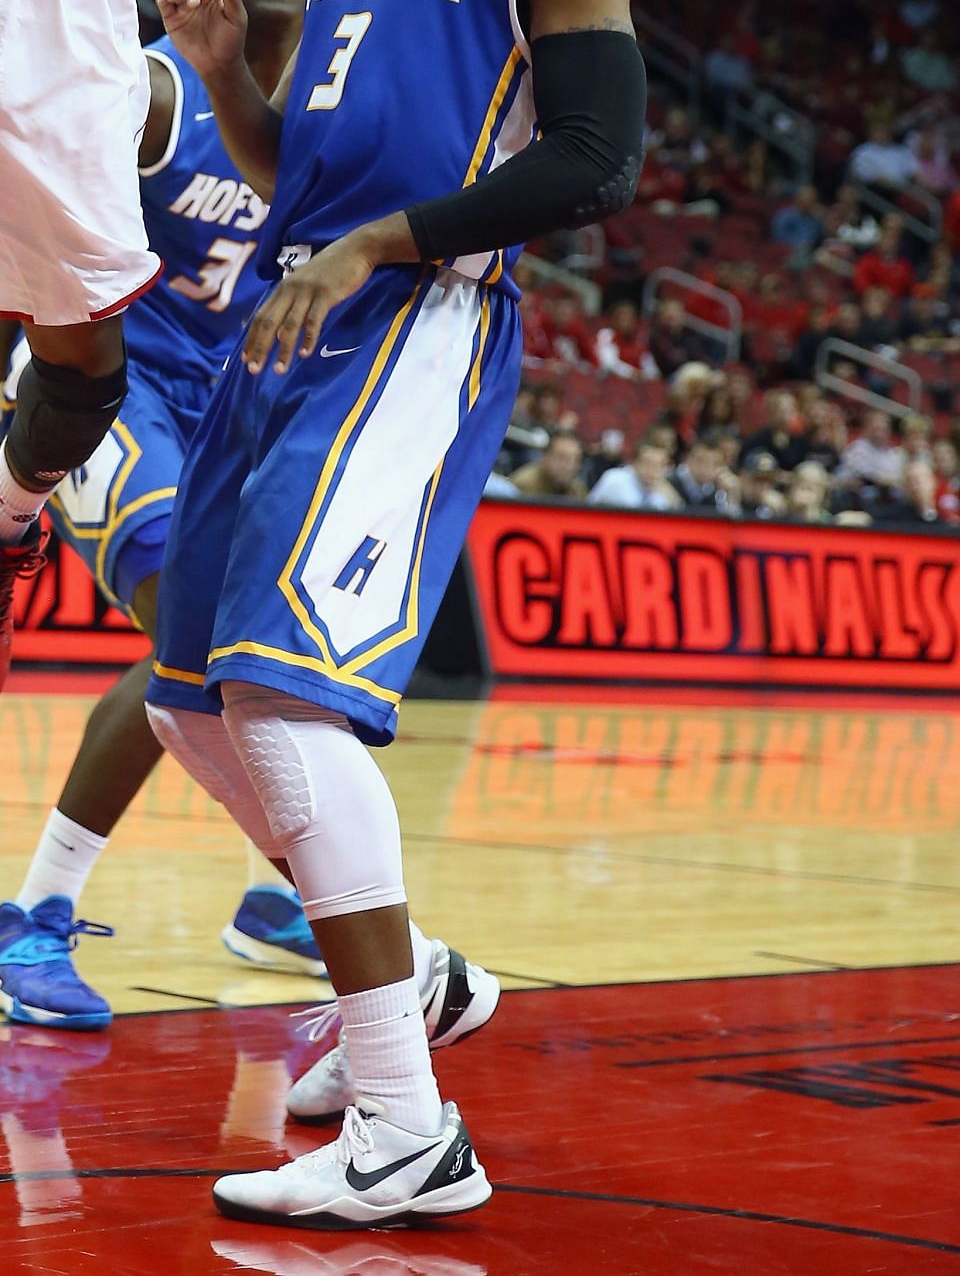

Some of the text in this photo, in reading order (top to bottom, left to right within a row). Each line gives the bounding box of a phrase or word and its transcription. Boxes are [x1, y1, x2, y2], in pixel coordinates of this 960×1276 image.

[306, 11, 373, 111] 3
[332, 534, 388, 597] H
[492, 529, 957, 664] CARDINALS
